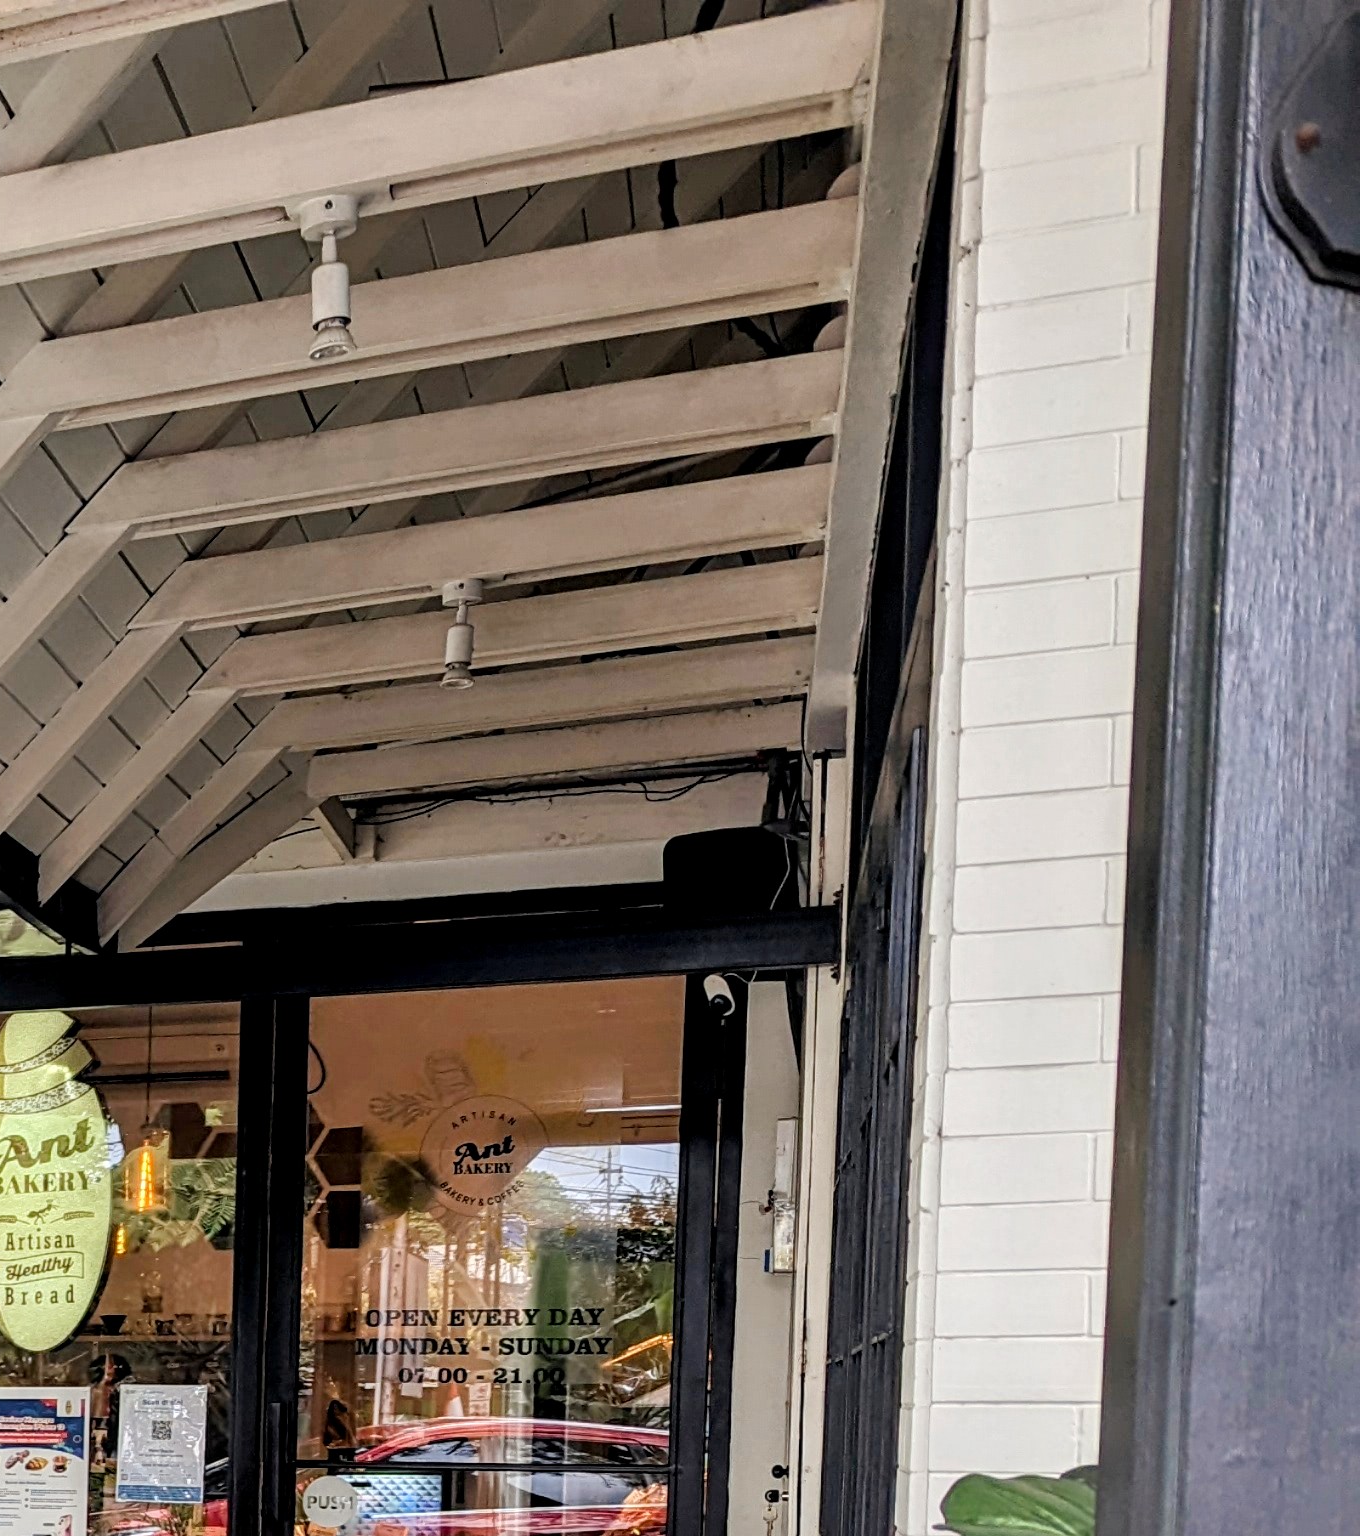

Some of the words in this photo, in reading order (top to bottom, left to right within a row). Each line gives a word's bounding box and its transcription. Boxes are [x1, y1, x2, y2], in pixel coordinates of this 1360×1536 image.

[452, 1110, 516, 1129] ARTISAN
[453, 1135, 515, 1165] Ant
[453, 1162, 513, 1175] BAKERY
[440, 1181, 476, 1206] BAKERY
[5, 1228, 75, 1251] Artisan
[6, 1255, 74, 1281] Healthy
[5, 1284, 75, 1306] Bread
[365, 1309, 438, 1327] OPEN
[447, 1308, 540, 1327] EVERY
[547, 1308, 605, 1326] DAY
[355, 1337, 471, 1356] MONDAY
[498, 1337, 612, 1356] SUNDAY
[493, 1367, 565, 1384] 21.00
